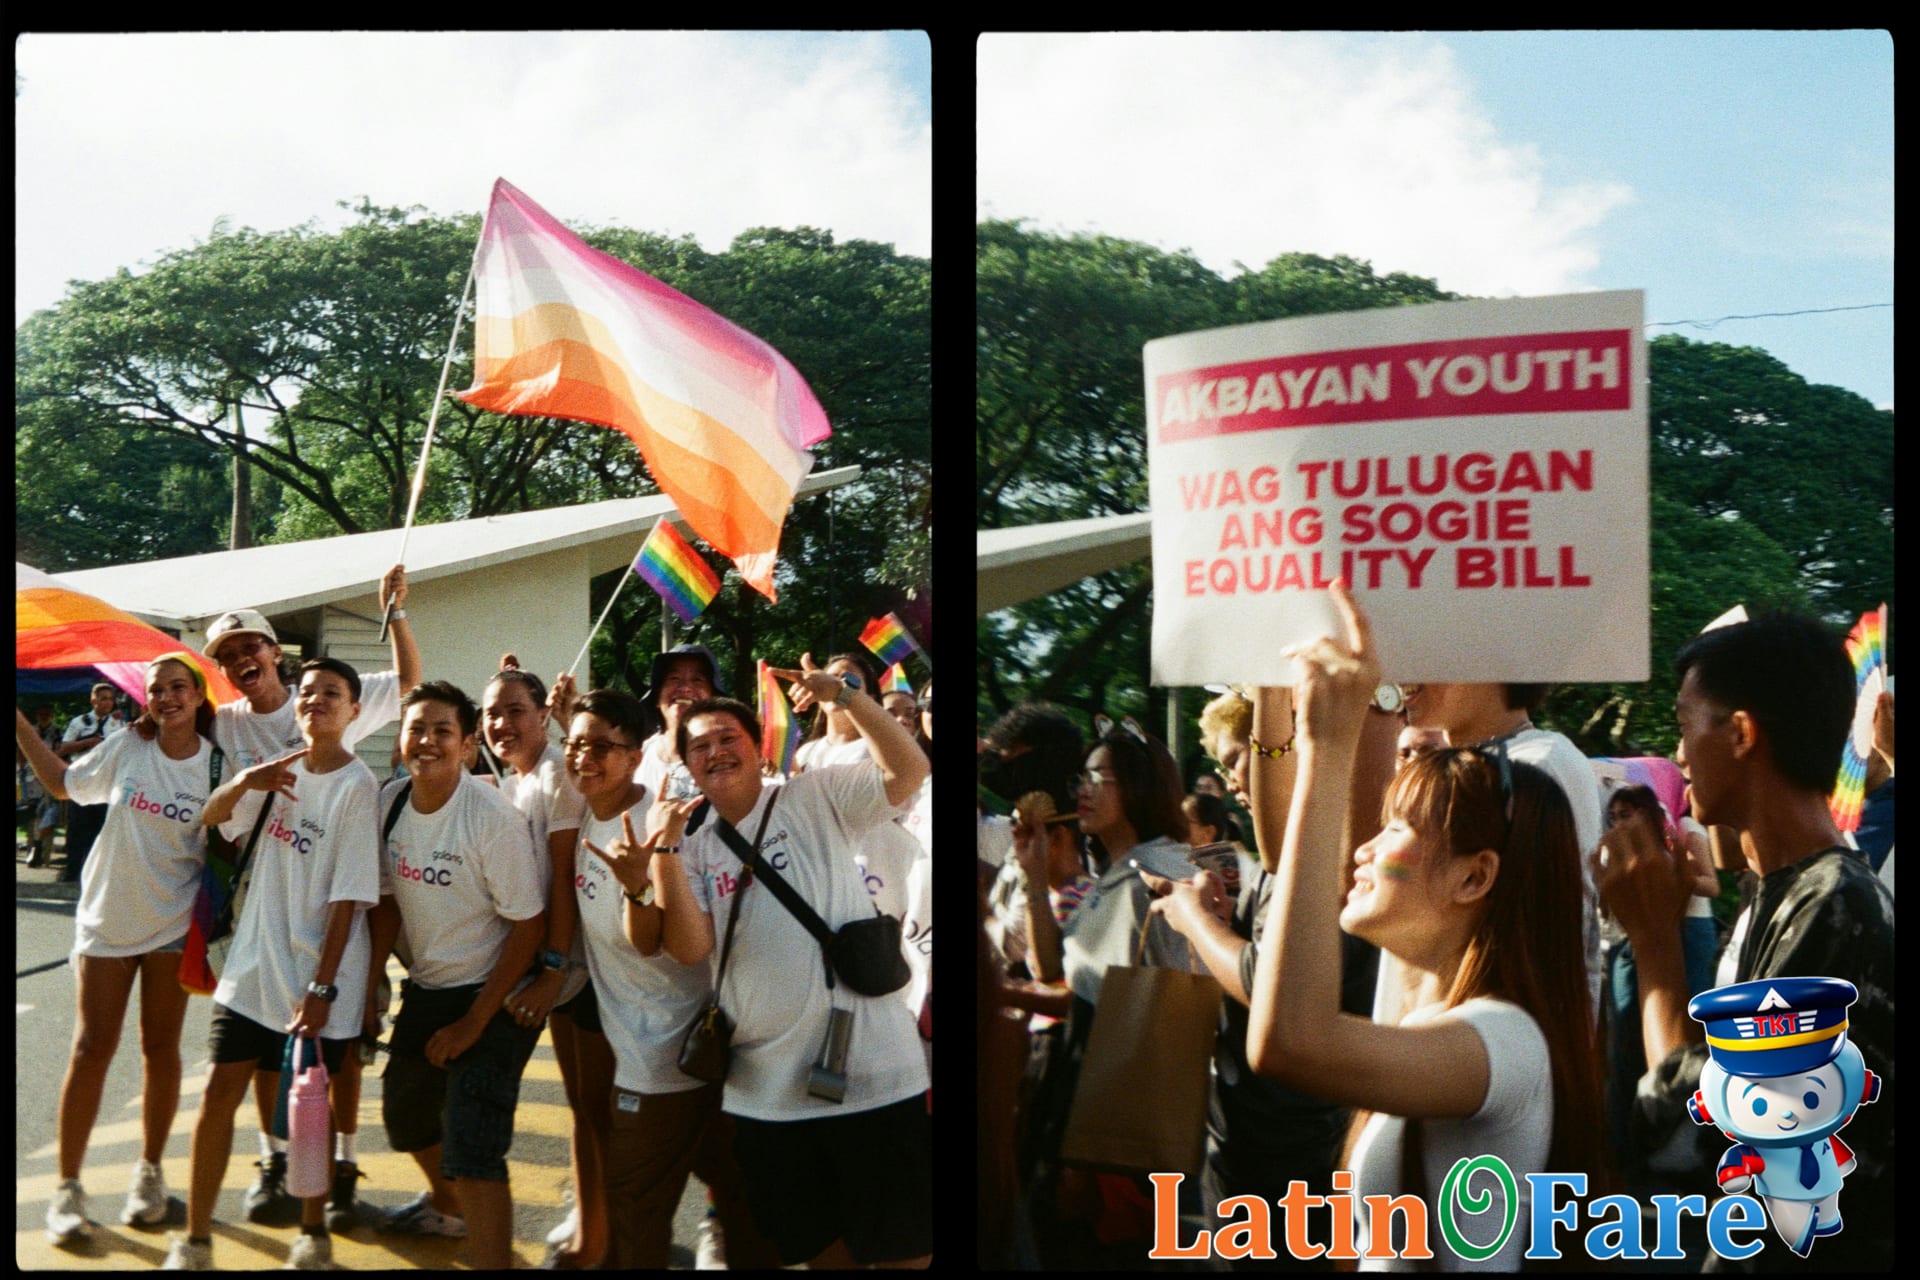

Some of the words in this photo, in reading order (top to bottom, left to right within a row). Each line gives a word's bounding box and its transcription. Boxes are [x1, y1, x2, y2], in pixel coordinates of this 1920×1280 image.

[1160, 360, 1393, 427] AKBAYAN
[1405, 346, 1622, 400] YOUTH
[1178, 465, 1281, 511] WAG
[1295, 448, 1595, 501] TULUGAN
[1218, 507, 1324, 551] ANG
[1340, 499, 1531, 545] SOGIE
[1185, 546, 1437, 597] EQUALITY
[1455, 545, 1592, 591] BILL
